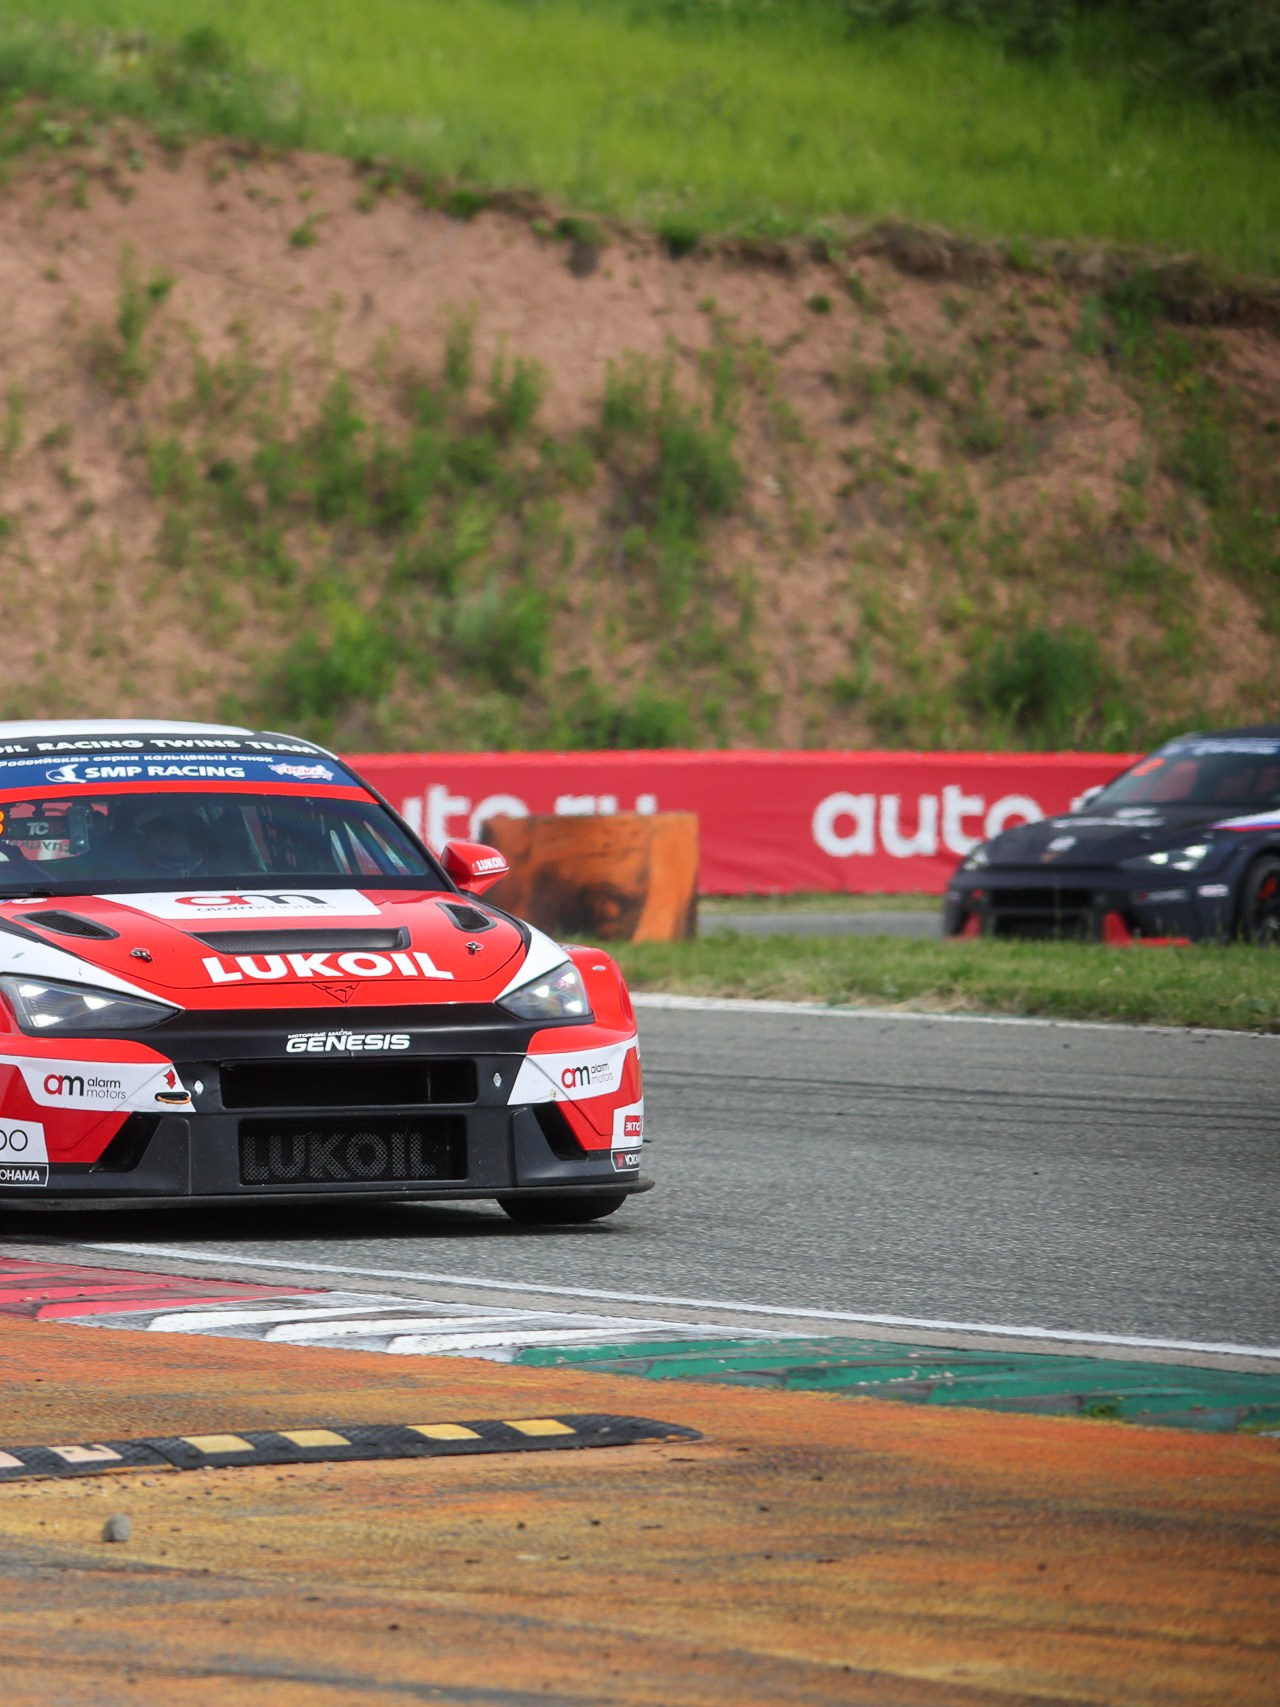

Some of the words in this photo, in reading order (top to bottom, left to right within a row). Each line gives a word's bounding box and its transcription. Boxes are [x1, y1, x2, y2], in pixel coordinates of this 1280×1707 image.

[36, 739, 144, 752] RACING
[149, 739, 241, 748] TWINS
[244, 741, 318, 755] TEAM
[85, 766, 142, 779] SMP
[147, 766, 245, 778] RACING
[202, 952, 454, 983] LUKOIL
[285, 1034, 411, 1053] GENESIS
[43, 1073, 85, 1097] am
[87, 1077, 121, 1089] alarm
[561, 1065, 591, 1089] am
[86, 1089, 126, 1100] motors
[242, 1132, 437, 1181] LUKOIL
